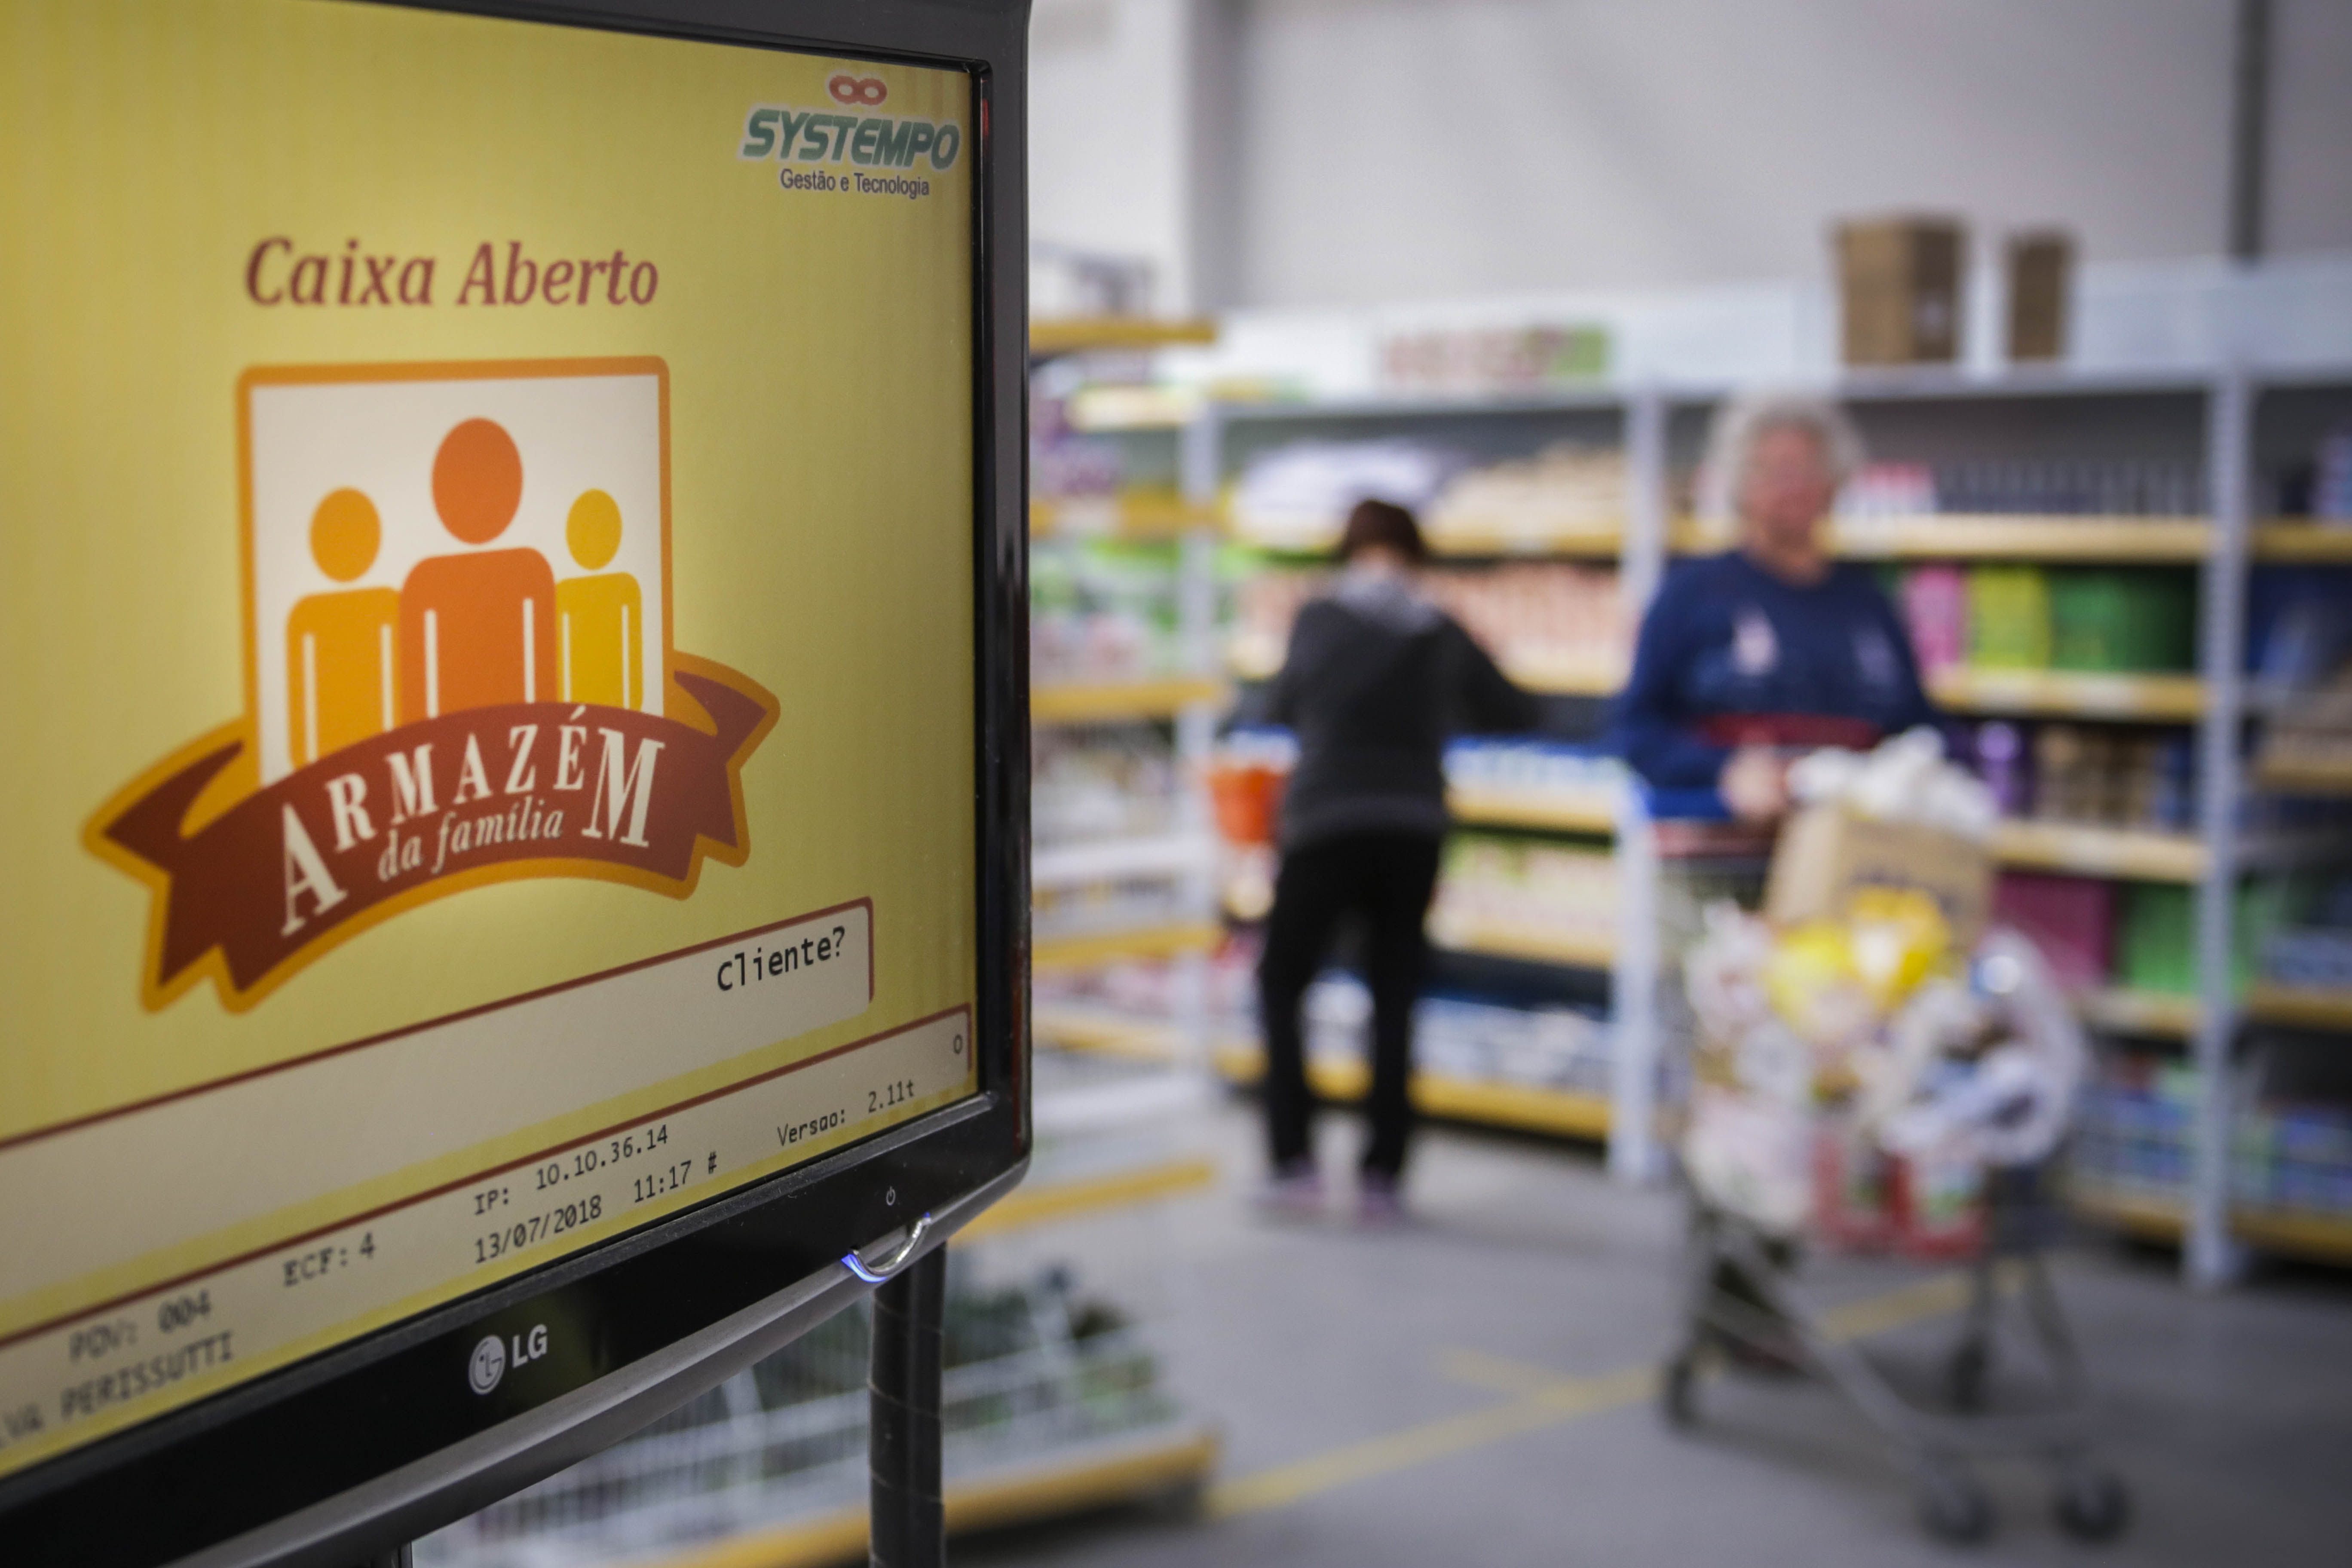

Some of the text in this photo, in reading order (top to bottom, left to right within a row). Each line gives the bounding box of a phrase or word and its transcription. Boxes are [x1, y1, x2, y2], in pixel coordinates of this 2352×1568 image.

[743, 108, 959, 170] SYSTEMPO
[780, 168, 930, 199] Gestão e Tecnologia
[245, 236, 659, 306] Caixa Aberto
[280, 704, 665, 937] ARMAZÉM
[377, 796, 564, 883] da família
[717, 925, 845, 991] Cliente?
[777, 1079, 914, 1147] Versao: 2.11t
[475, 1124, 668, 1215] IP: 10.10.36.14
[360, 1231, 376, 1259] 4
[475, 1194, 601, 1264] 13/07/2018
[634, 1160, 692, 1203] 11:17
[60, 1329, 233, 1419] PERISSUTTI
[512, 1323, 548, 1369] LG
